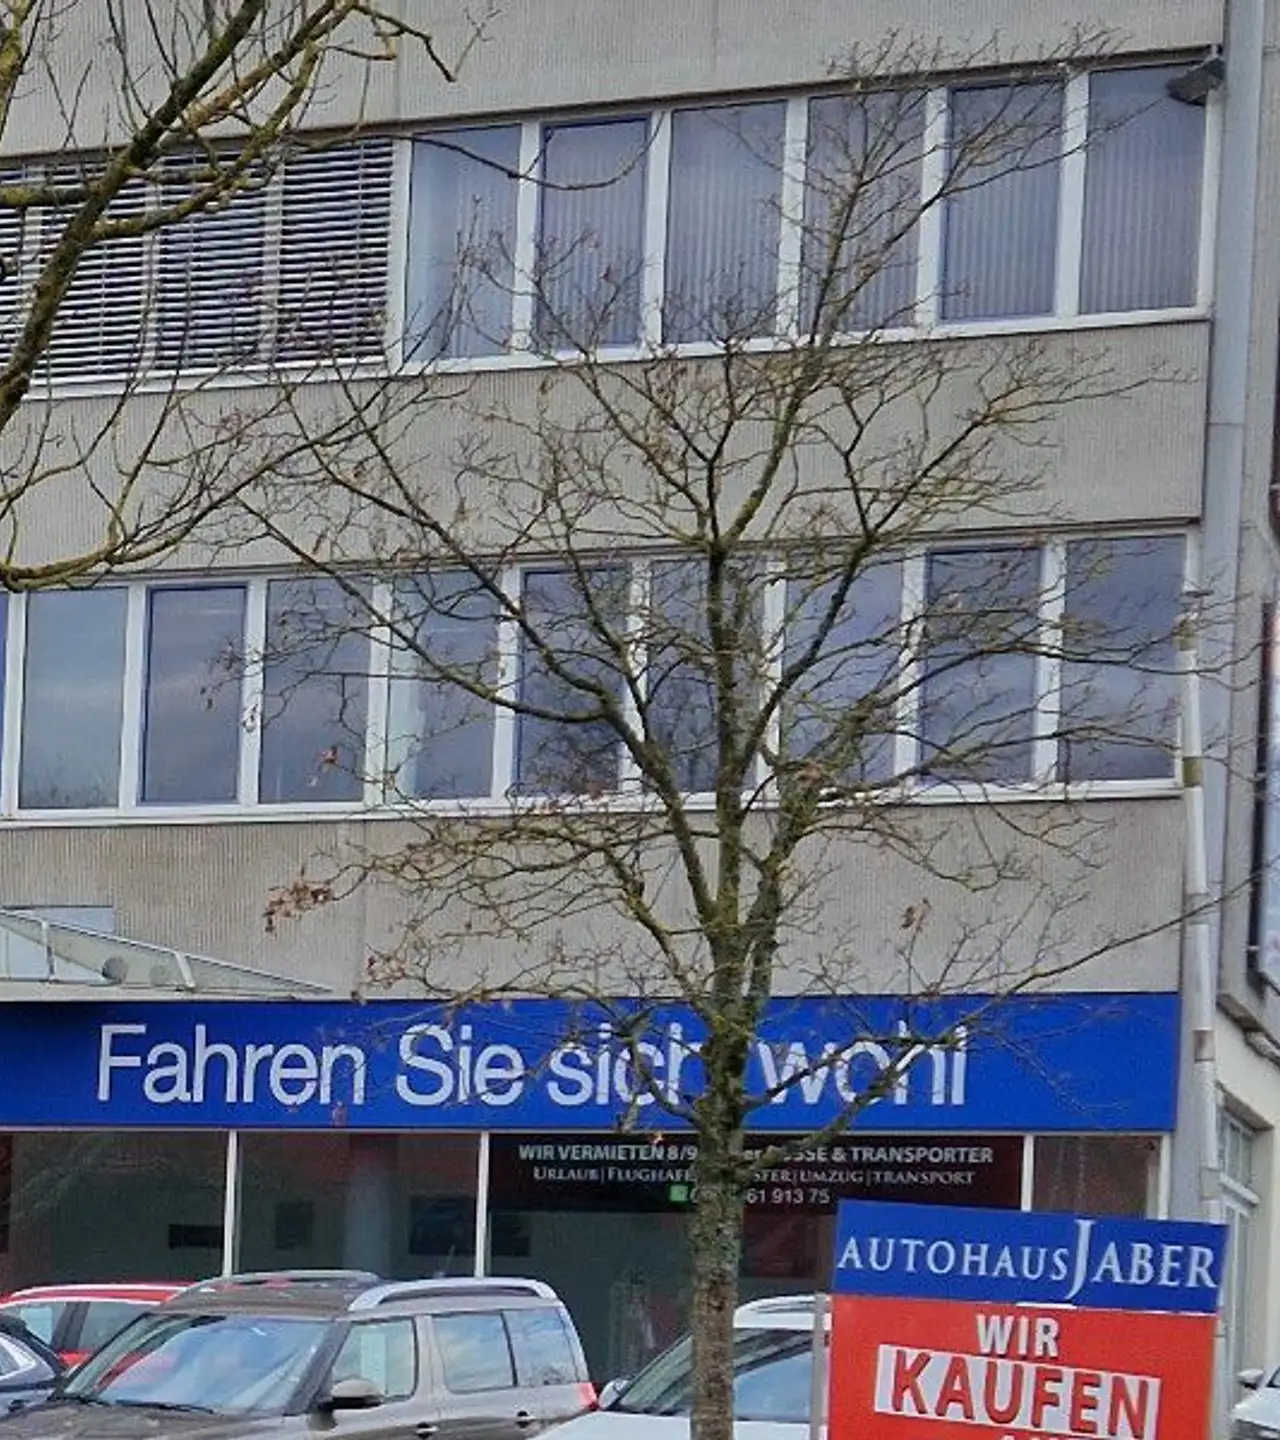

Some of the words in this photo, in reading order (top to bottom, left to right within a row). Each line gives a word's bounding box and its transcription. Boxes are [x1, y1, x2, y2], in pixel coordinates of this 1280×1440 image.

[96, 1023, 366, 1106] Fahren
[395, 1022, 523, 1107] Sie
[756, 1020, 967, 1106] wohl
[519, 1145, 556, 1161] WIR
[558, 1144, 666, 1161] VERMIETEN
[852, 1146, 994, 1164] TRANSPORTER
[838, 1236, 1068, 1281] AUTOHAUS
[1064, 1219, 1218, 1300] JABER
[976, 1313, 1059, 1359] WIR
[891, 1349, 1150, 1439] KAUFEN
